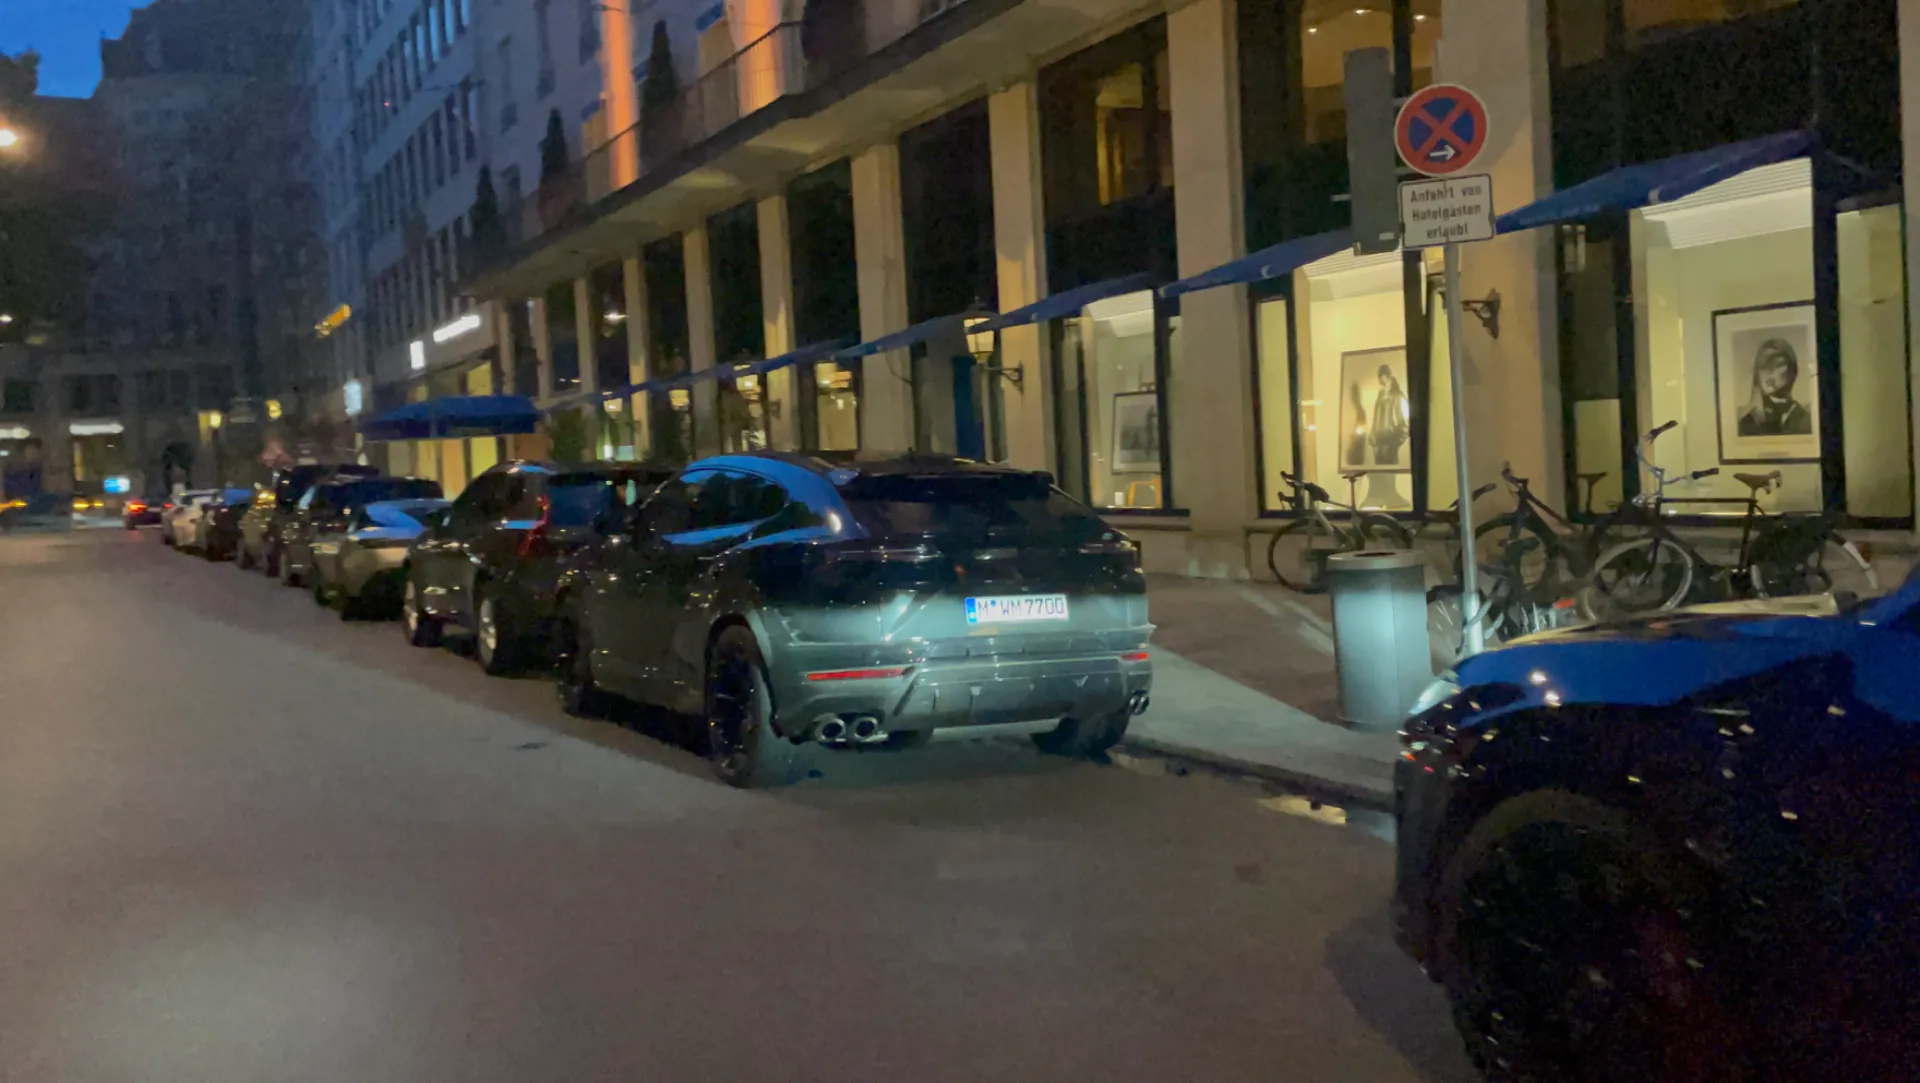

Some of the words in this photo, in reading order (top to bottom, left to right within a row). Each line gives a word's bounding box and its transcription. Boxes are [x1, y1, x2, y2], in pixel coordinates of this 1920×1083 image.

[1410, 186, 1454, 203] Anfahrt
[1461, 185, 1482, 197] von
[1427, 223, 1468, 239] erlaubt
[977, 599, 989, 616] M
[1024, 597, 1065, 616] 7700
